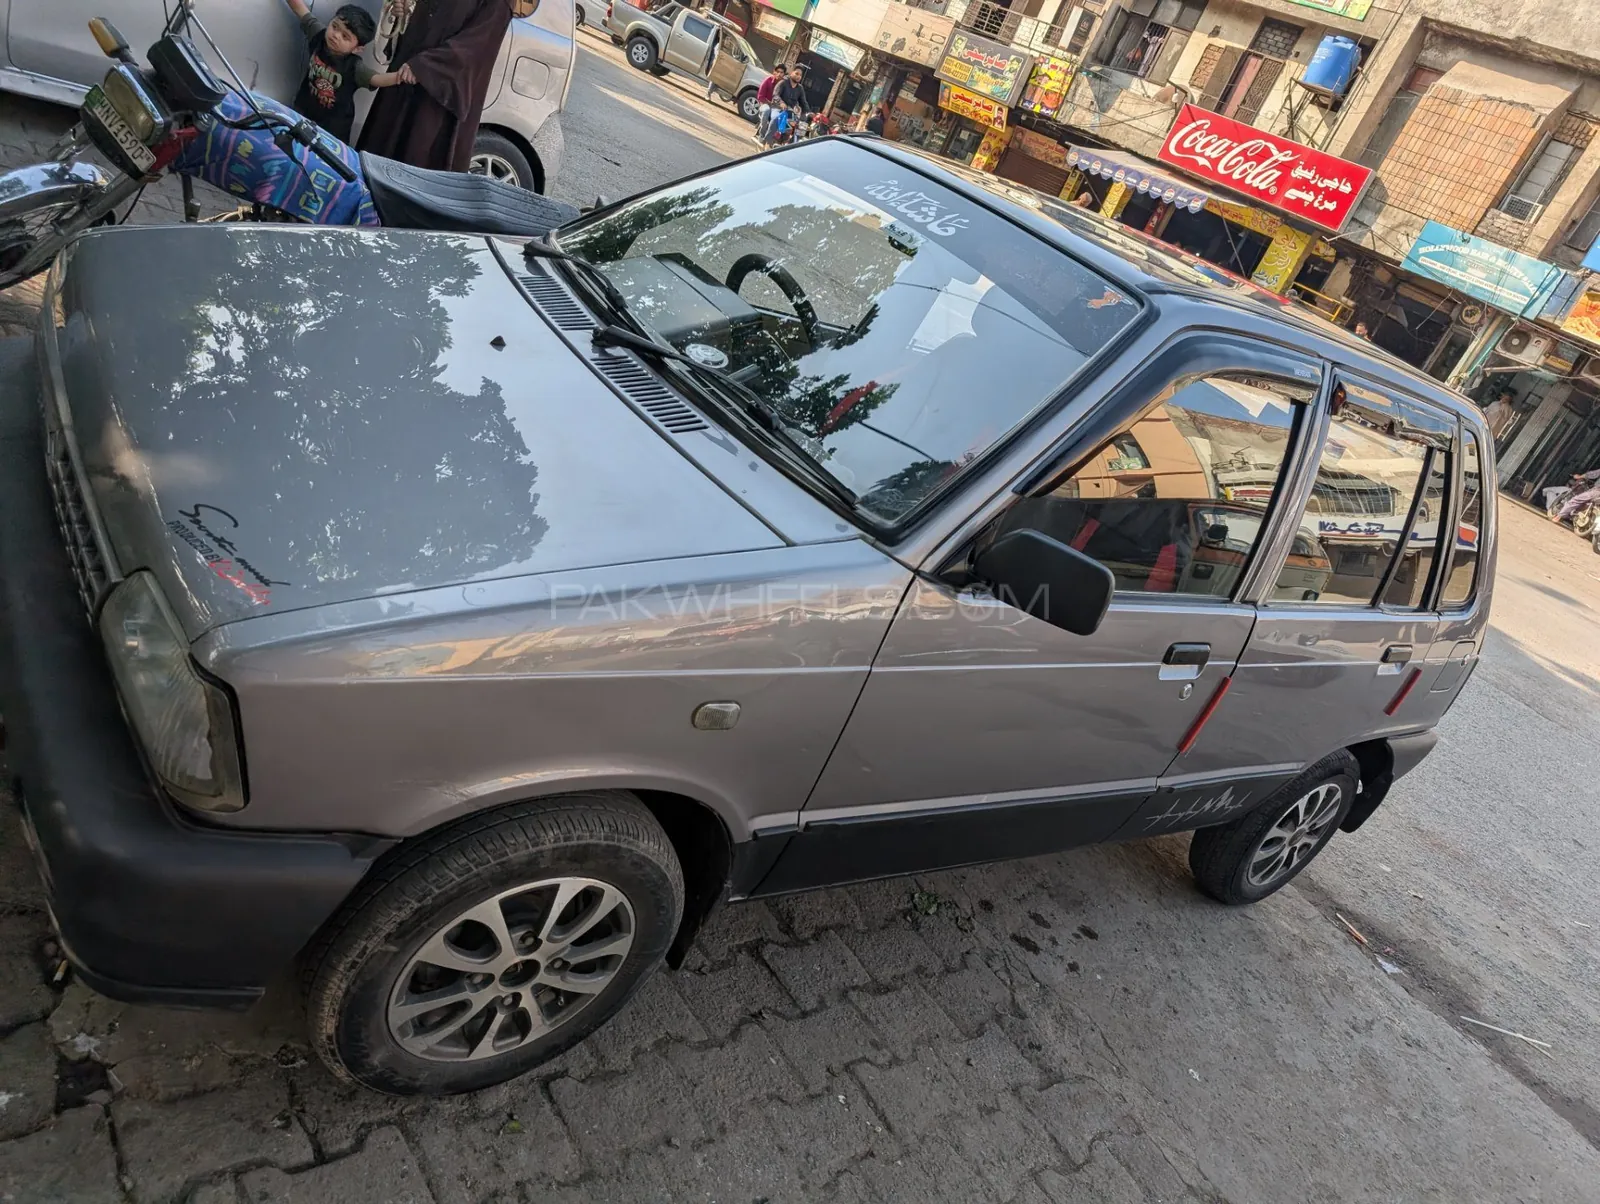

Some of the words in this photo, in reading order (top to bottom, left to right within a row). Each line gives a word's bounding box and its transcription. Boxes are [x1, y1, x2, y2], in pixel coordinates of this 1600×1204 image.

[1168, 119, 1302, 191] Coca-Cola
[1290, 161, 1320, 184] رفیق
[1318, 173, 1353, 194] حاجی
